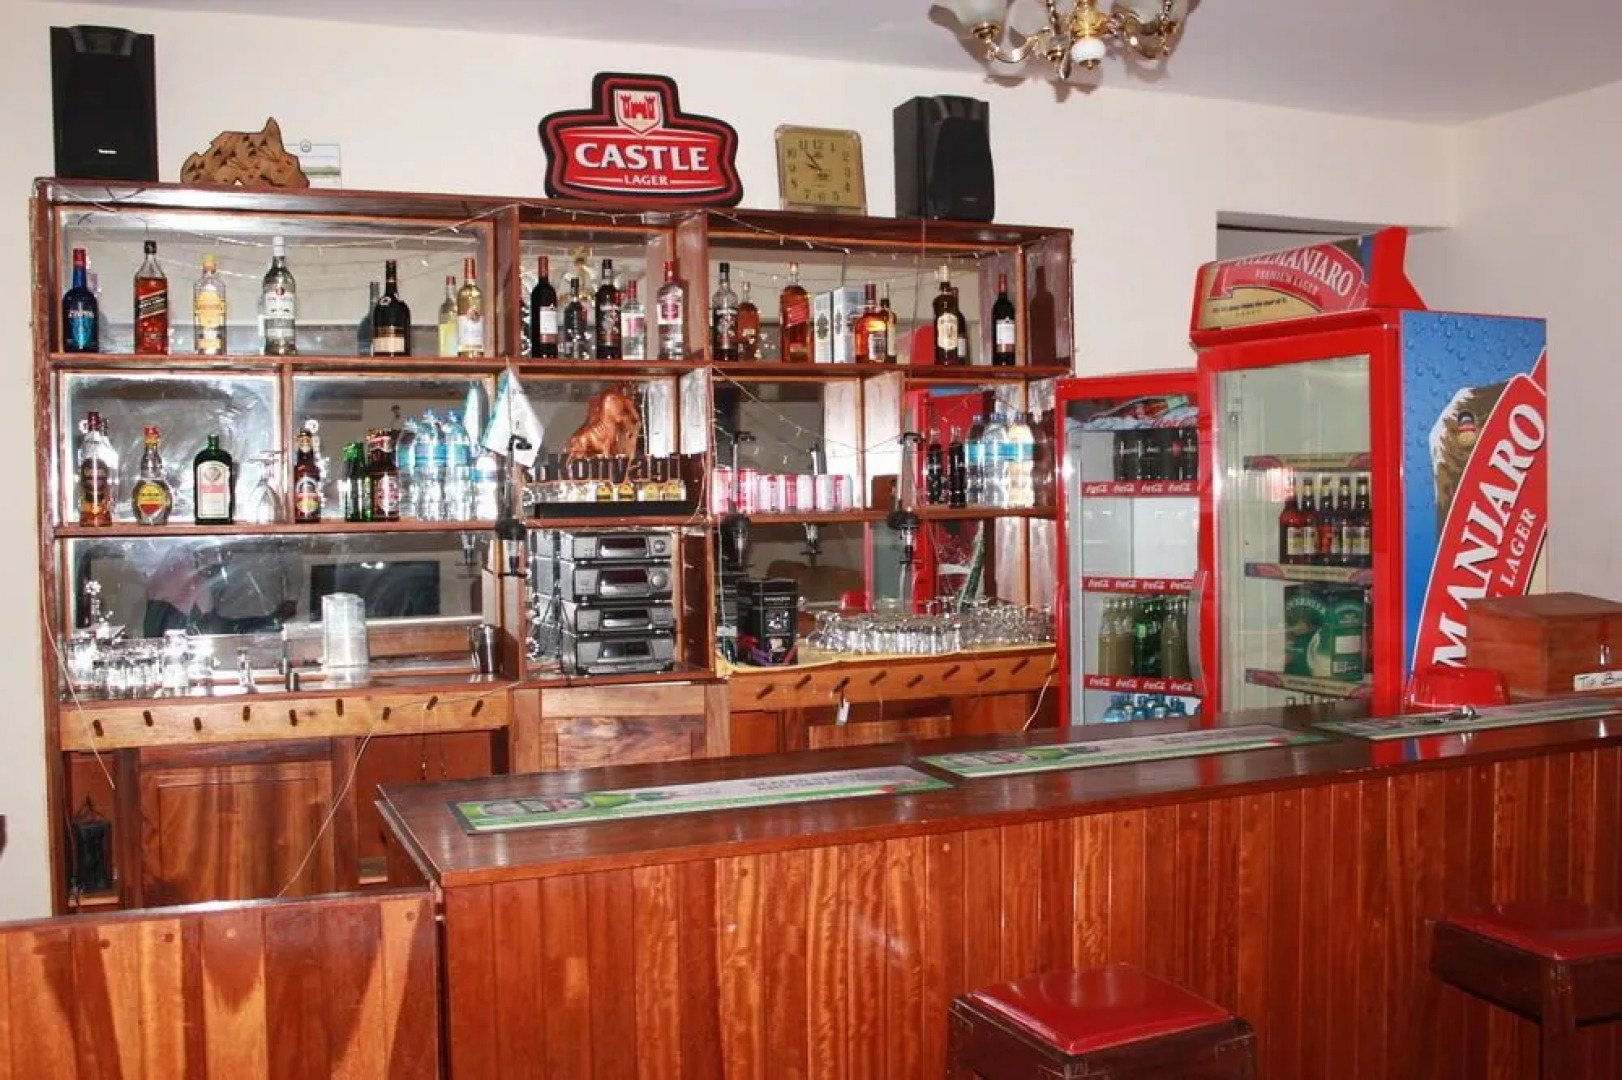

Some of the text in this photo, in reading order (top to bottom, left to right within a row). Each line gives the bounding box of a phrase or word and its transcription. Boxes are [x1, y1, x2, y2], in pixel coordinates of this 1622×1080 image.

[574, 142, 710, 171] CASTLE
[622, 174, 669, 185] LAGER
[1500, 507, 1537, 588] LAGER
